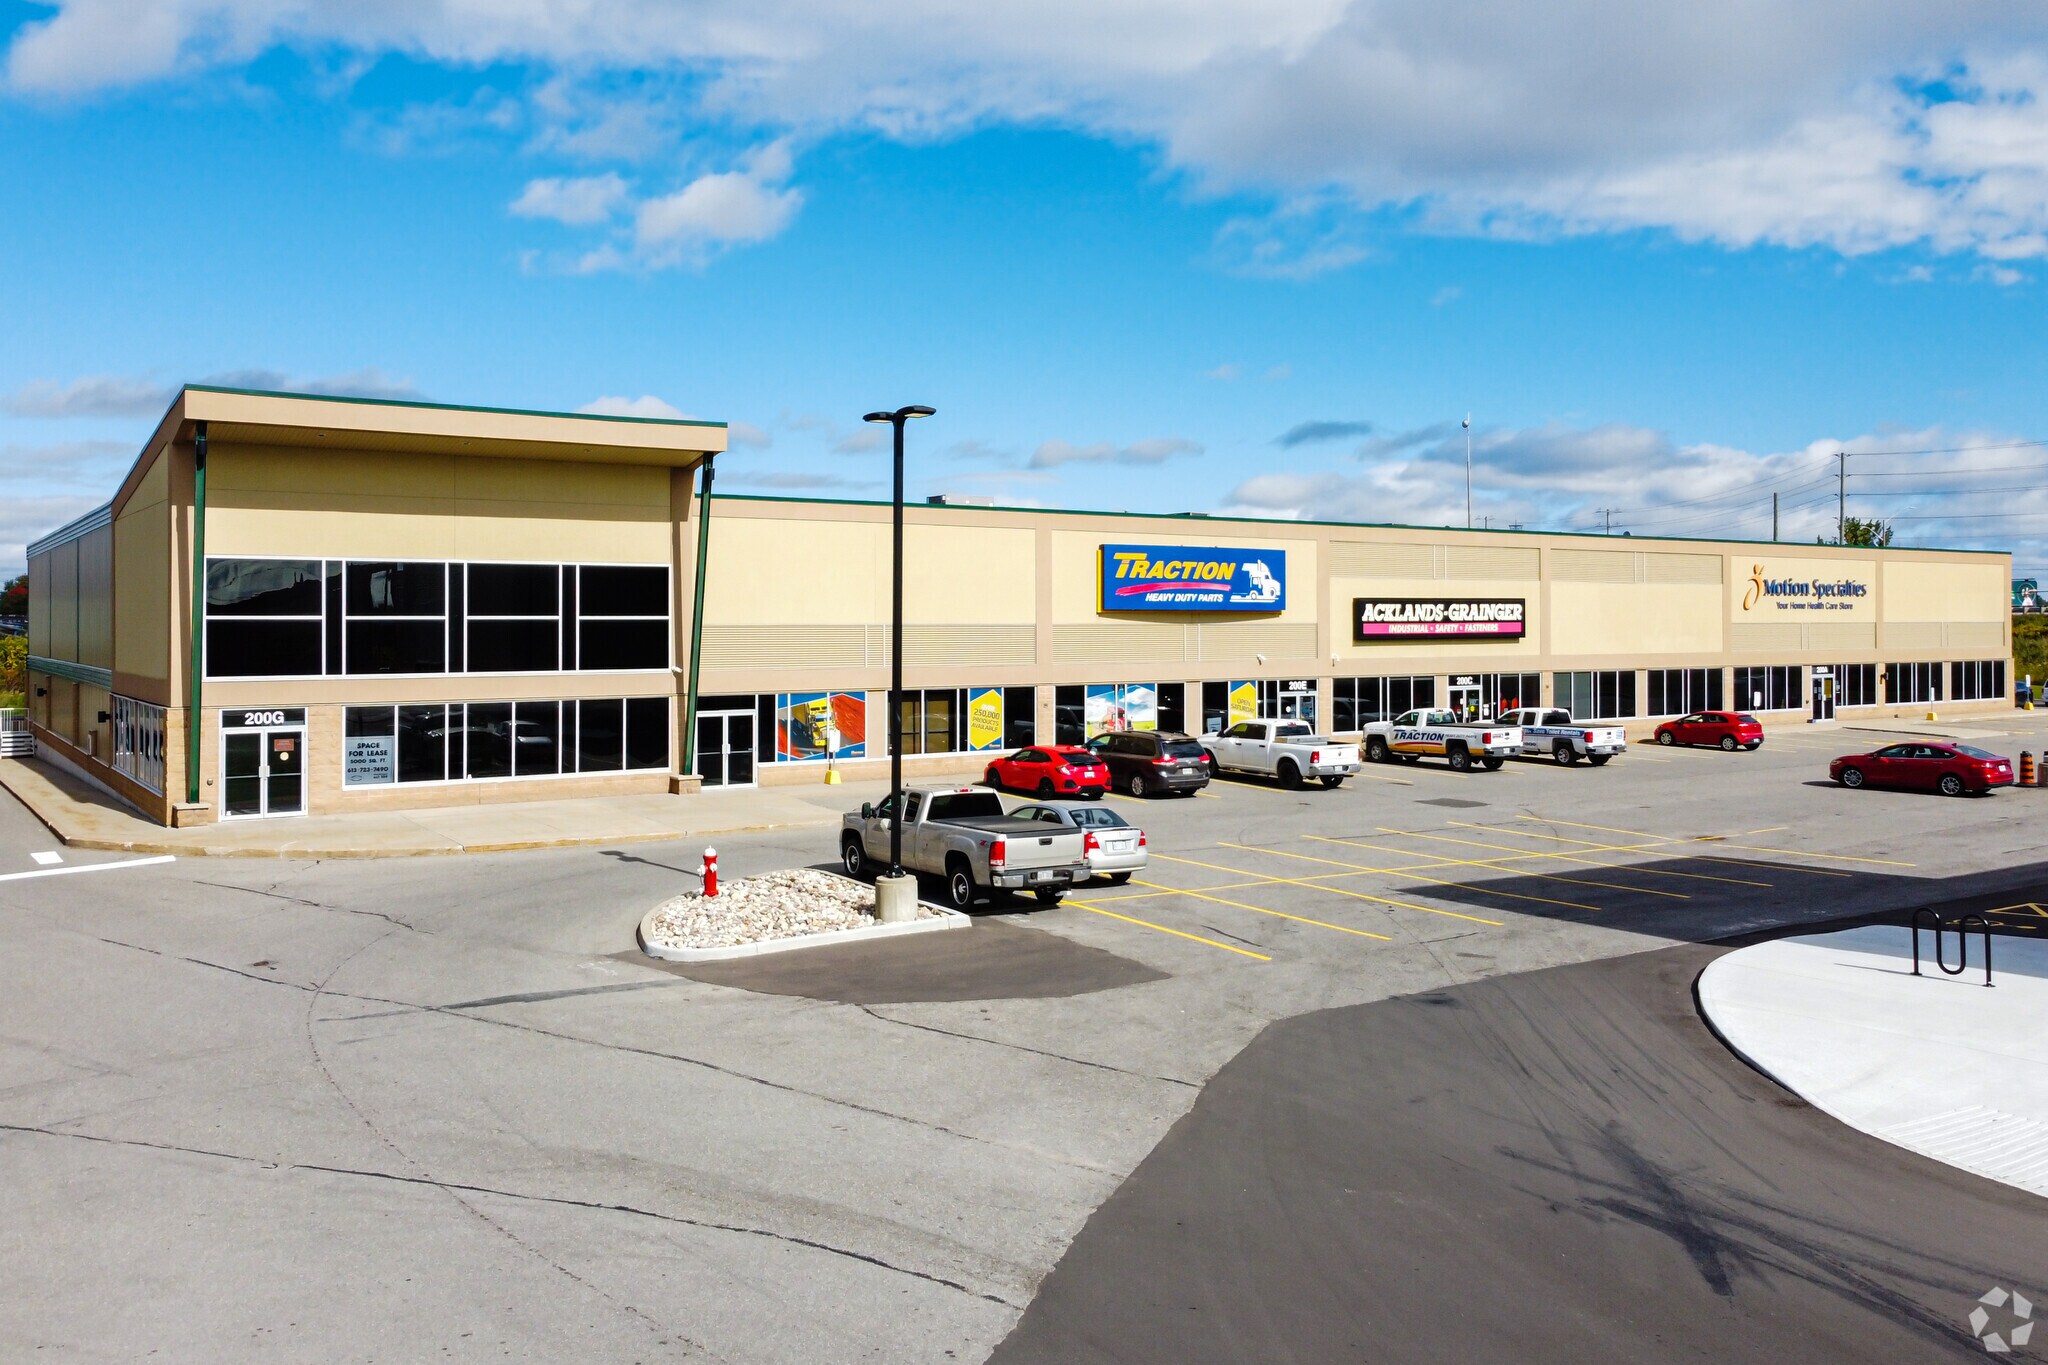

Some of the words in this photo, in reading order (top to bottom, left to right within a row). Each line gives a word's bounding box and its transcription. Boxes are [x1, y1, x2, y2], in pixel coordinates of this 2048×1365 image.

[1113, 552, 1236, 580] TRACTION
[1763, 579, 1810, 597] Motion
[1811, 579, 1867, 600] Specialties
[1145, 592, 1174, 602] HEAVY
[1174, 592, 1198, 603] DUTY
[1198, 593, 1223, 603] PARTS
[1789, 602, 1806, 610] Home
[1807, 602, 1825, 610] Health
[1825, 602, 1838, 610] Care
[1839, 602, 1853, 610] Store
[1289, 681, 1307, 690] 200E
[1456, 676, 1473, 685] 200C
[244, 711, 284, 725] 200G
[1394, 729, 1444, 741] TRACTION
